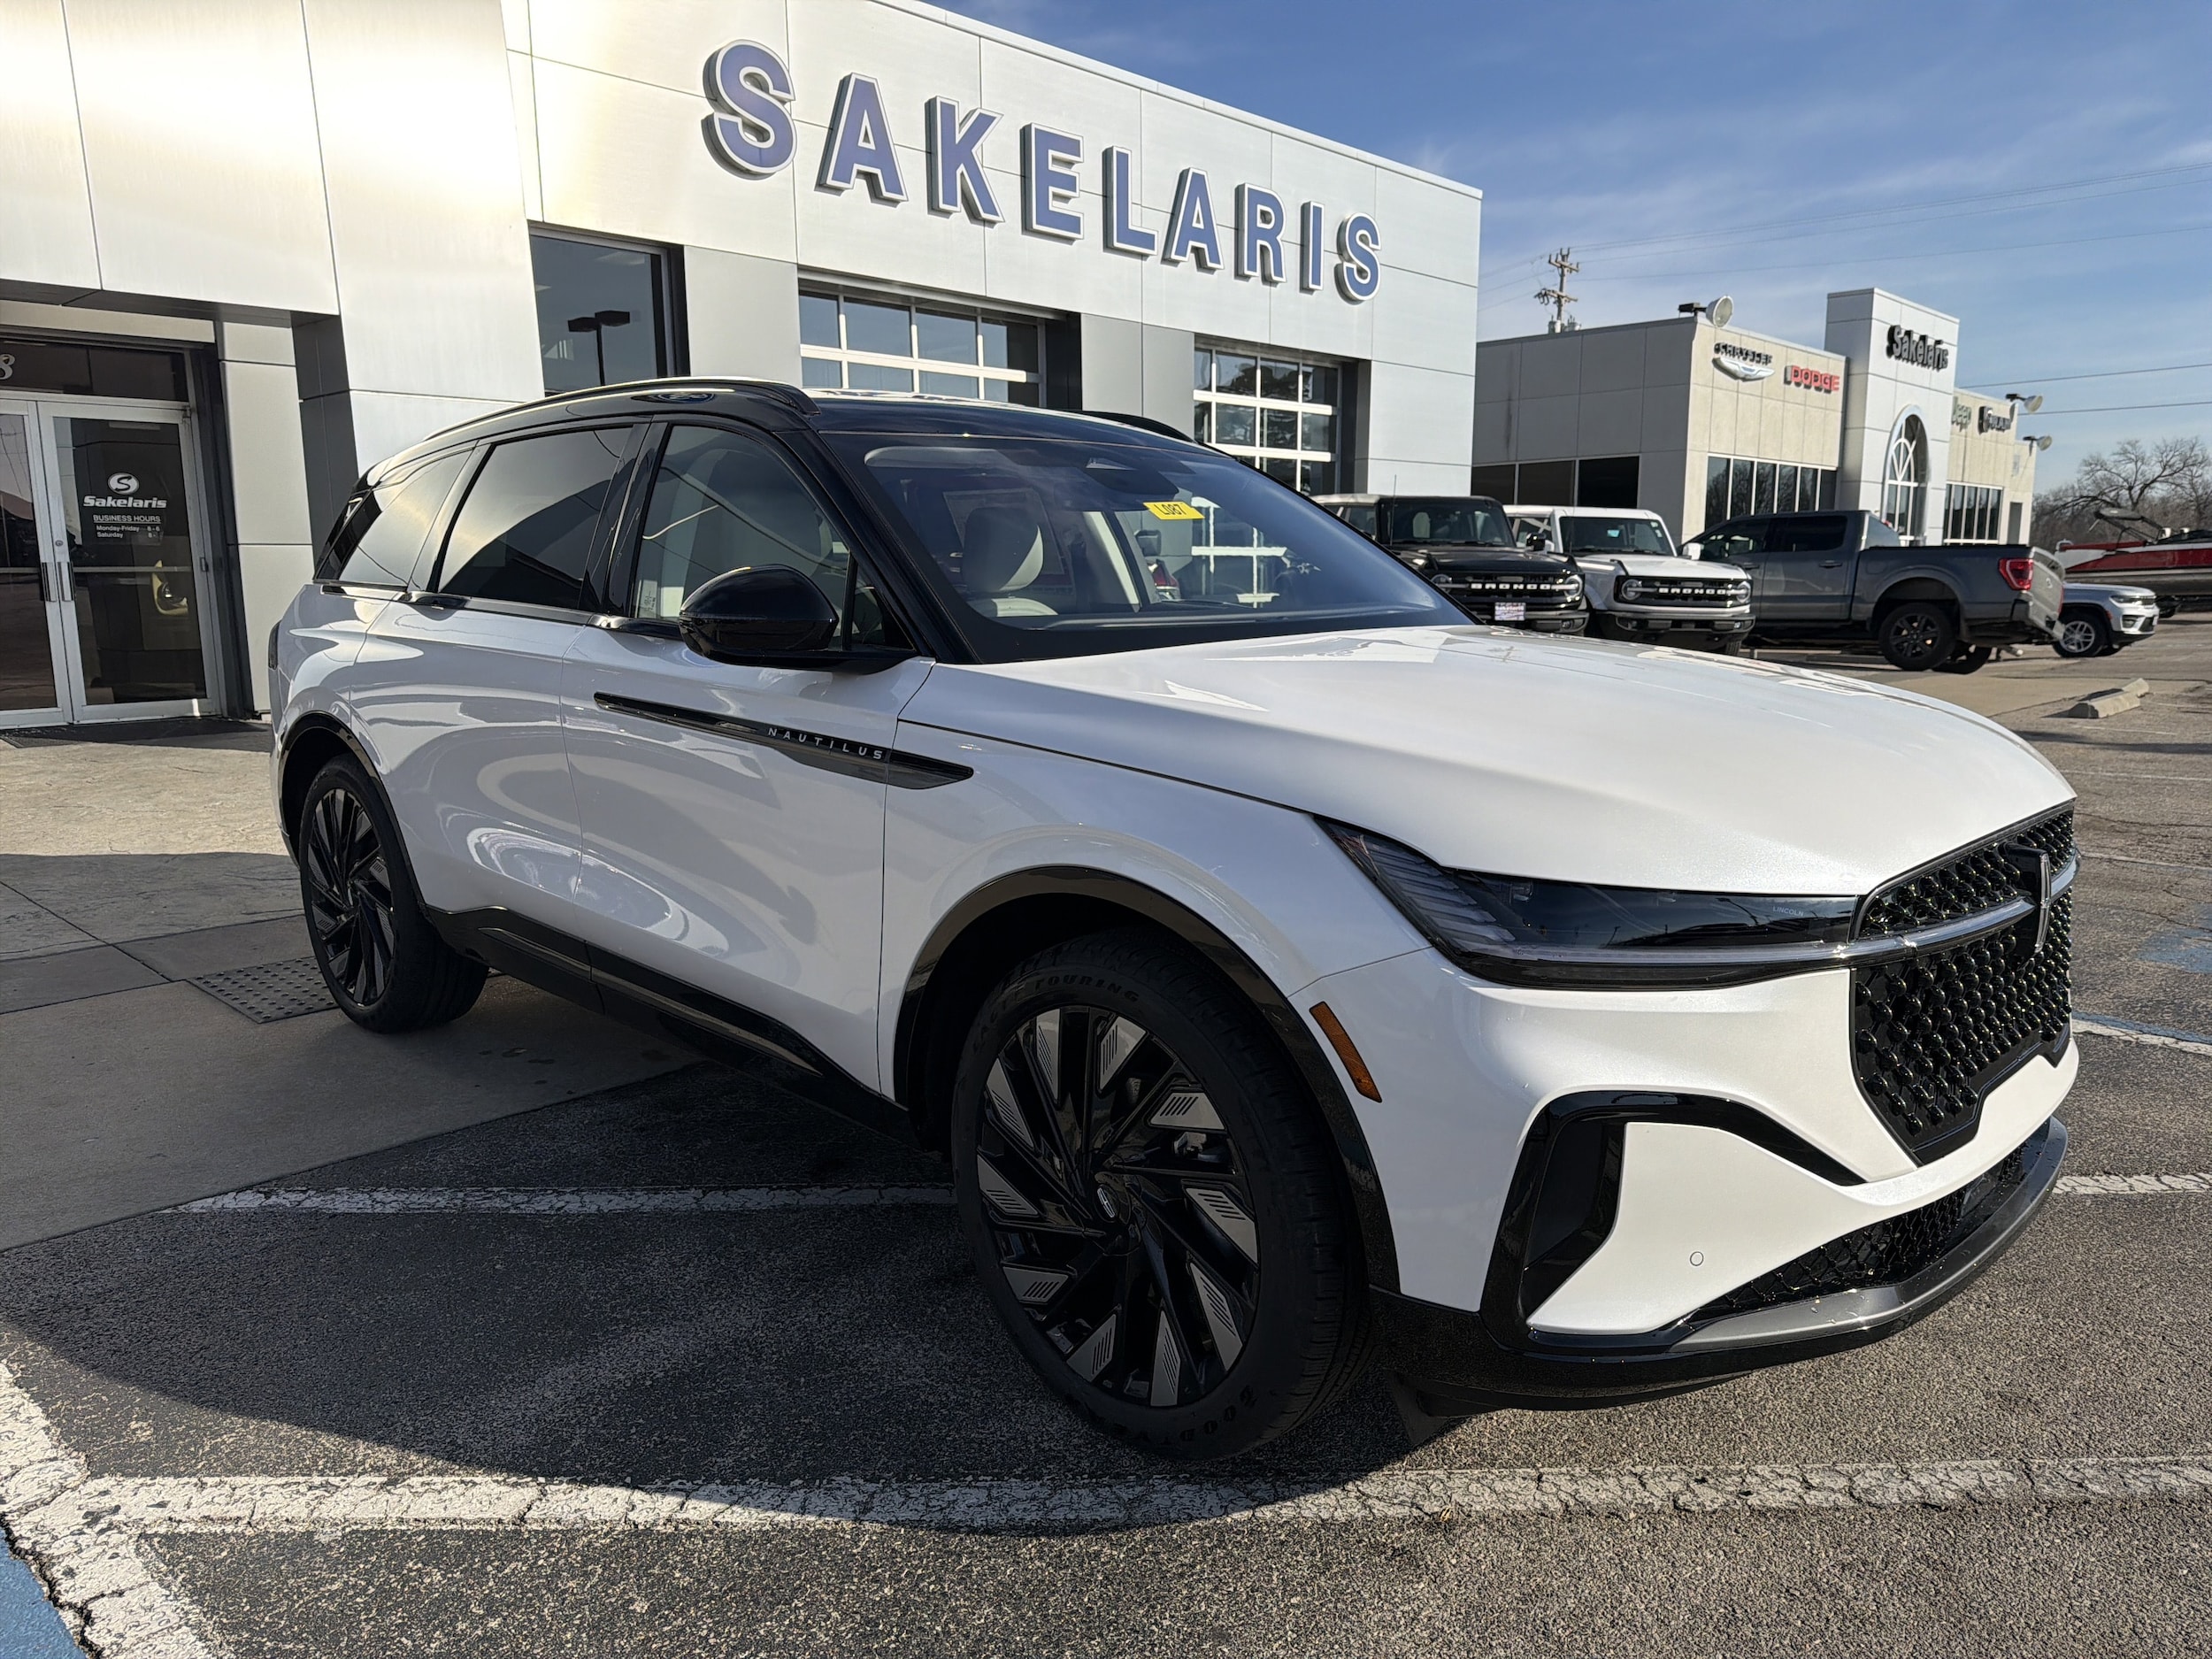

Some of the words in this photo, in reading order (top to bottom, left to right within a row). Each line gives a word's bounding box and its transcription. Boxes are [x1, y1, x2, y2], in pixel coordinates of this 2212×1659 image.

[703, 39, 1382, 303] SAKELARIS
[1887, 325, 1948, 371] Sakelaris
[1786, 365, 1840, 393] DODGE
[83, 495, 167, 509] Sakelaris
[768, 727, 883, 760] NAUTILUS
[1772, 906, 1804, 917] LINCOLN
[1034, 974, 1140, 1002] TOURING
